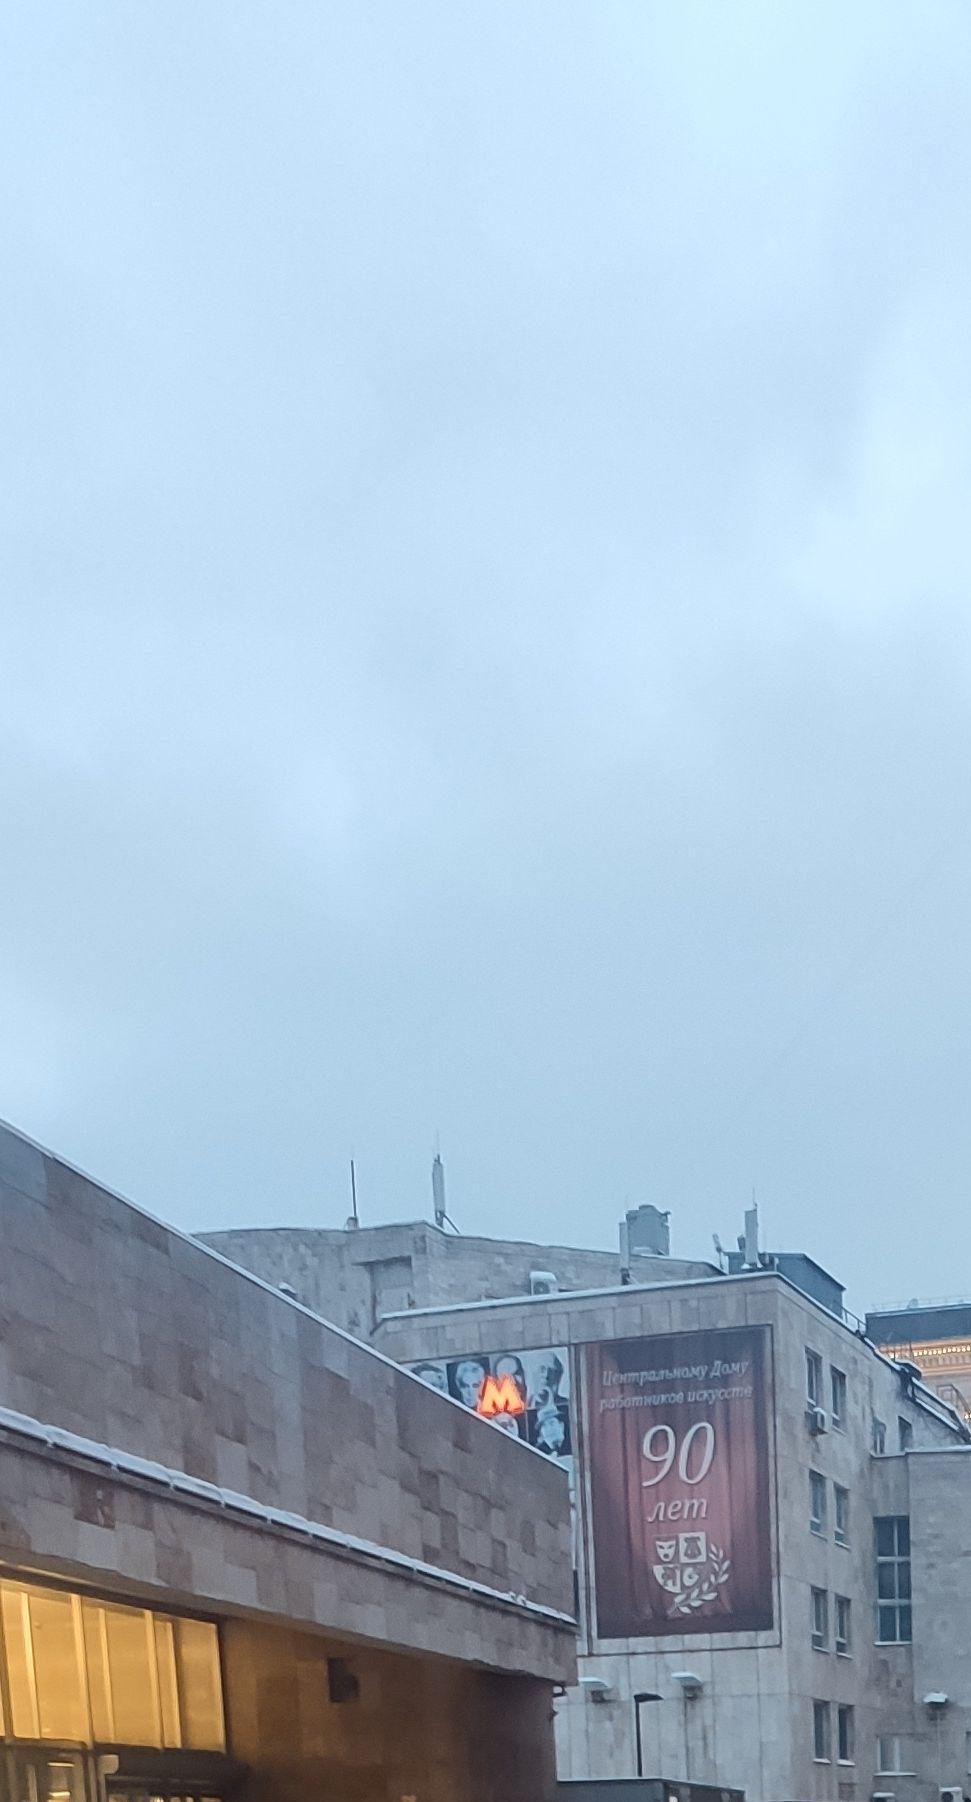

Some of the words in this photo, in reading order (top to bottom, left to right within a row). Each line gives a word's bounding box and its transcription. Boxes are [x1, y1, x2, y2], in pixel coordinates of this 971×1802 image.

[602, 1365, 708, 1386] Центральному
[710, 1360, 750, 1377] Дому
[600, 1391, 684, 1412] работников
[687, 1386, 753, 1404] искусств
[641, 1421, 716, 1488] 90
[647, 1498, 708, 1523] лет
